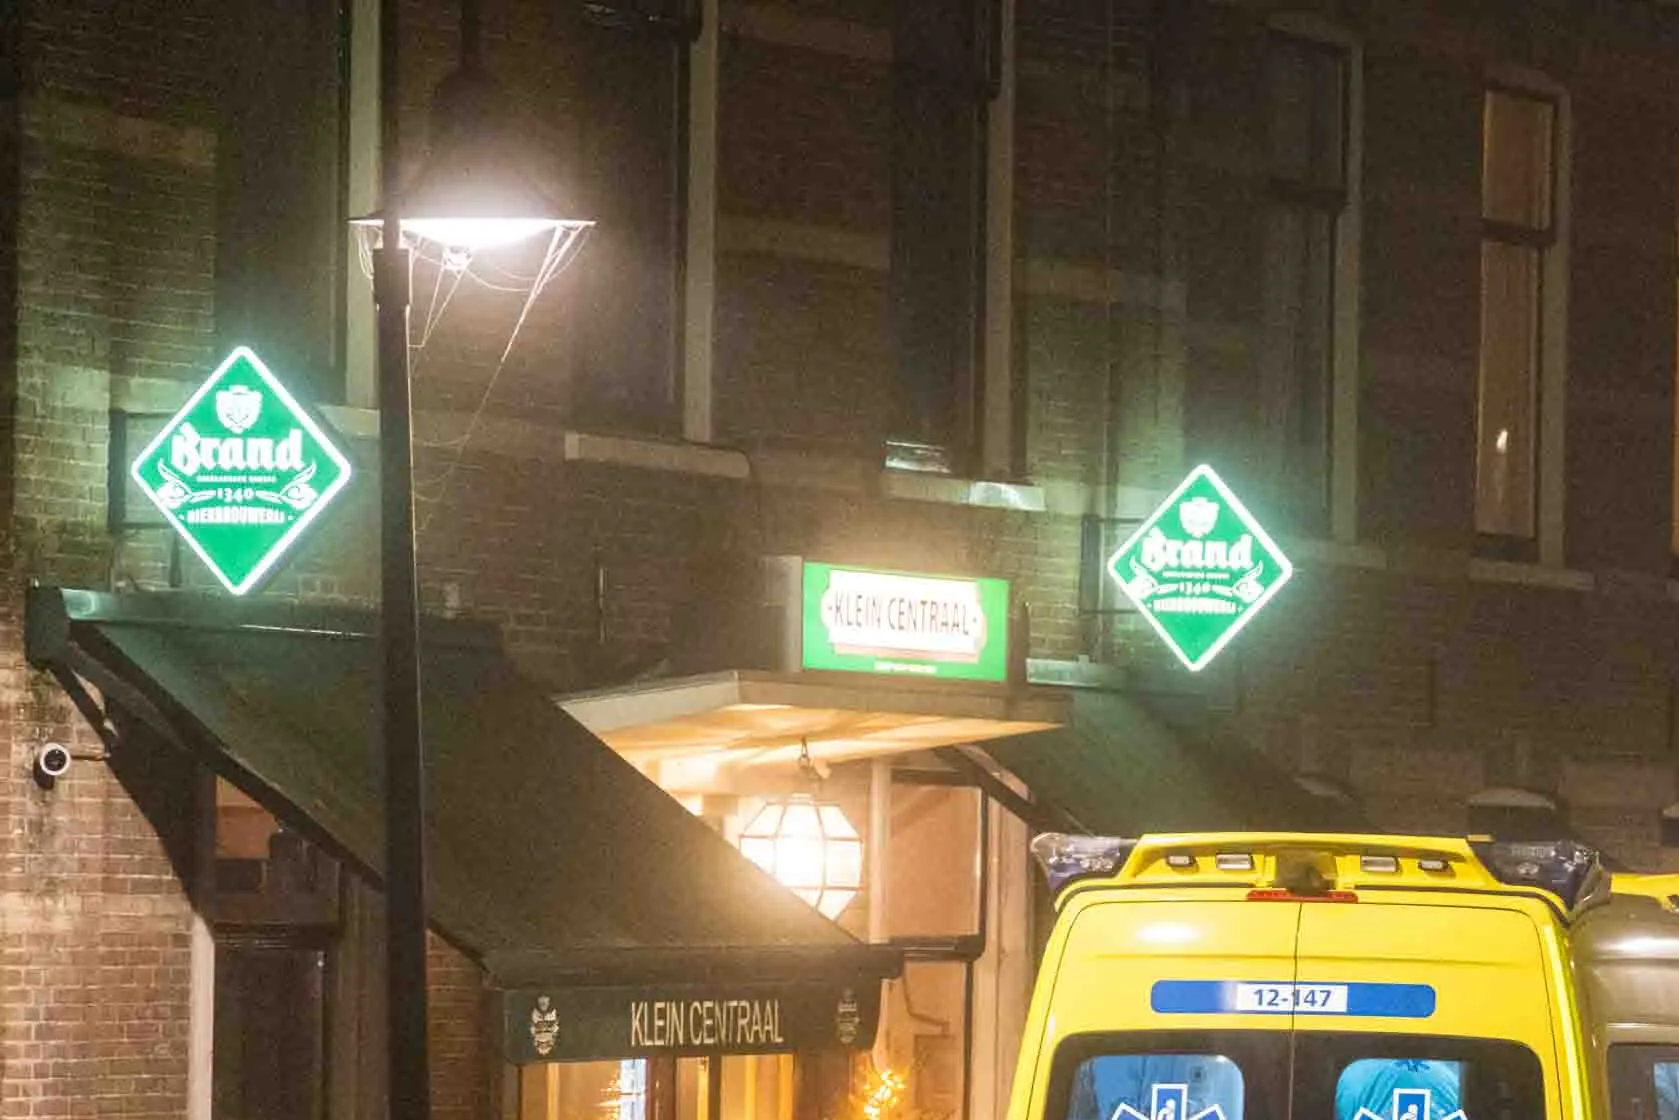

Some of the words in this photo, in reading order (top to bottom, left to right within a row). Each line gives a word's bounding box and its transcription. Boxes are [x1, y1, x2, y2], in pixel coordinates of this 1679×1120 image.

[171, 422, 305, 476] Brand
[1140, 526, 1254, 572] Brand
[833, 590, 882, 629] KLEIN
[887, 597, 970, 637] CENTRAAL
[1253, 989, 1332, 1008] 12-147
[630, 1001, 684, 1047] KLEIN
[689, 1000, 784, 1043] CENTRAAL
